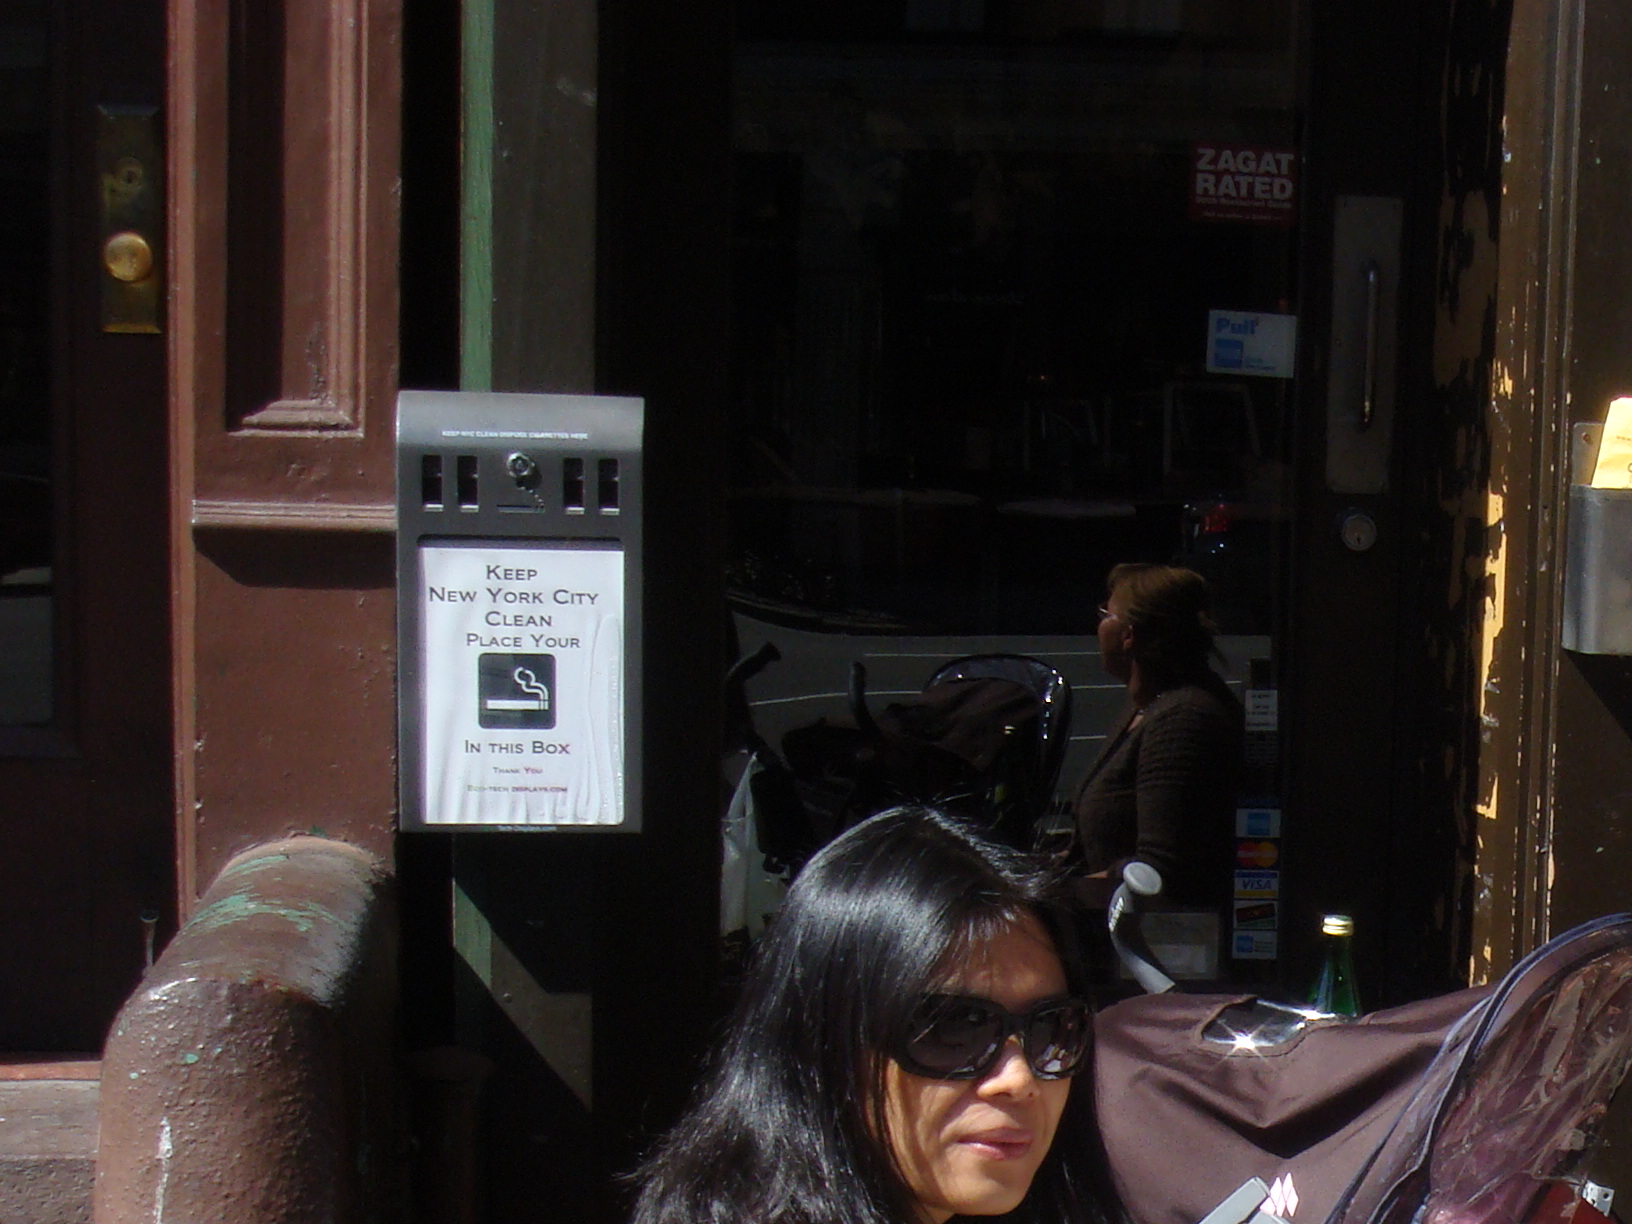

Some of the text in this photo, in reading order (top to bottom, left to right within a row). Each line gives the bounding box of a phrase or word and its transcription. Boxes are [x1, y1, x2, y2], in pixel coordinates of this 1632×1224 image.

[1197, 148, 1295, 175] ZAGAT
[1196, 172, 1294, 200] RATED
[486, 565, 538, 581] KEEP
[429, 587, 598, 605] NEW YORK CITY
[485, 611, 552, 627] CLEAN
[466, 633, 580, 648] PLACE YOUR
[488, 743, 524, 754] THIS
[531, 740, 570, 754] BOX
[1242, 879, 1272, 891] VISA
